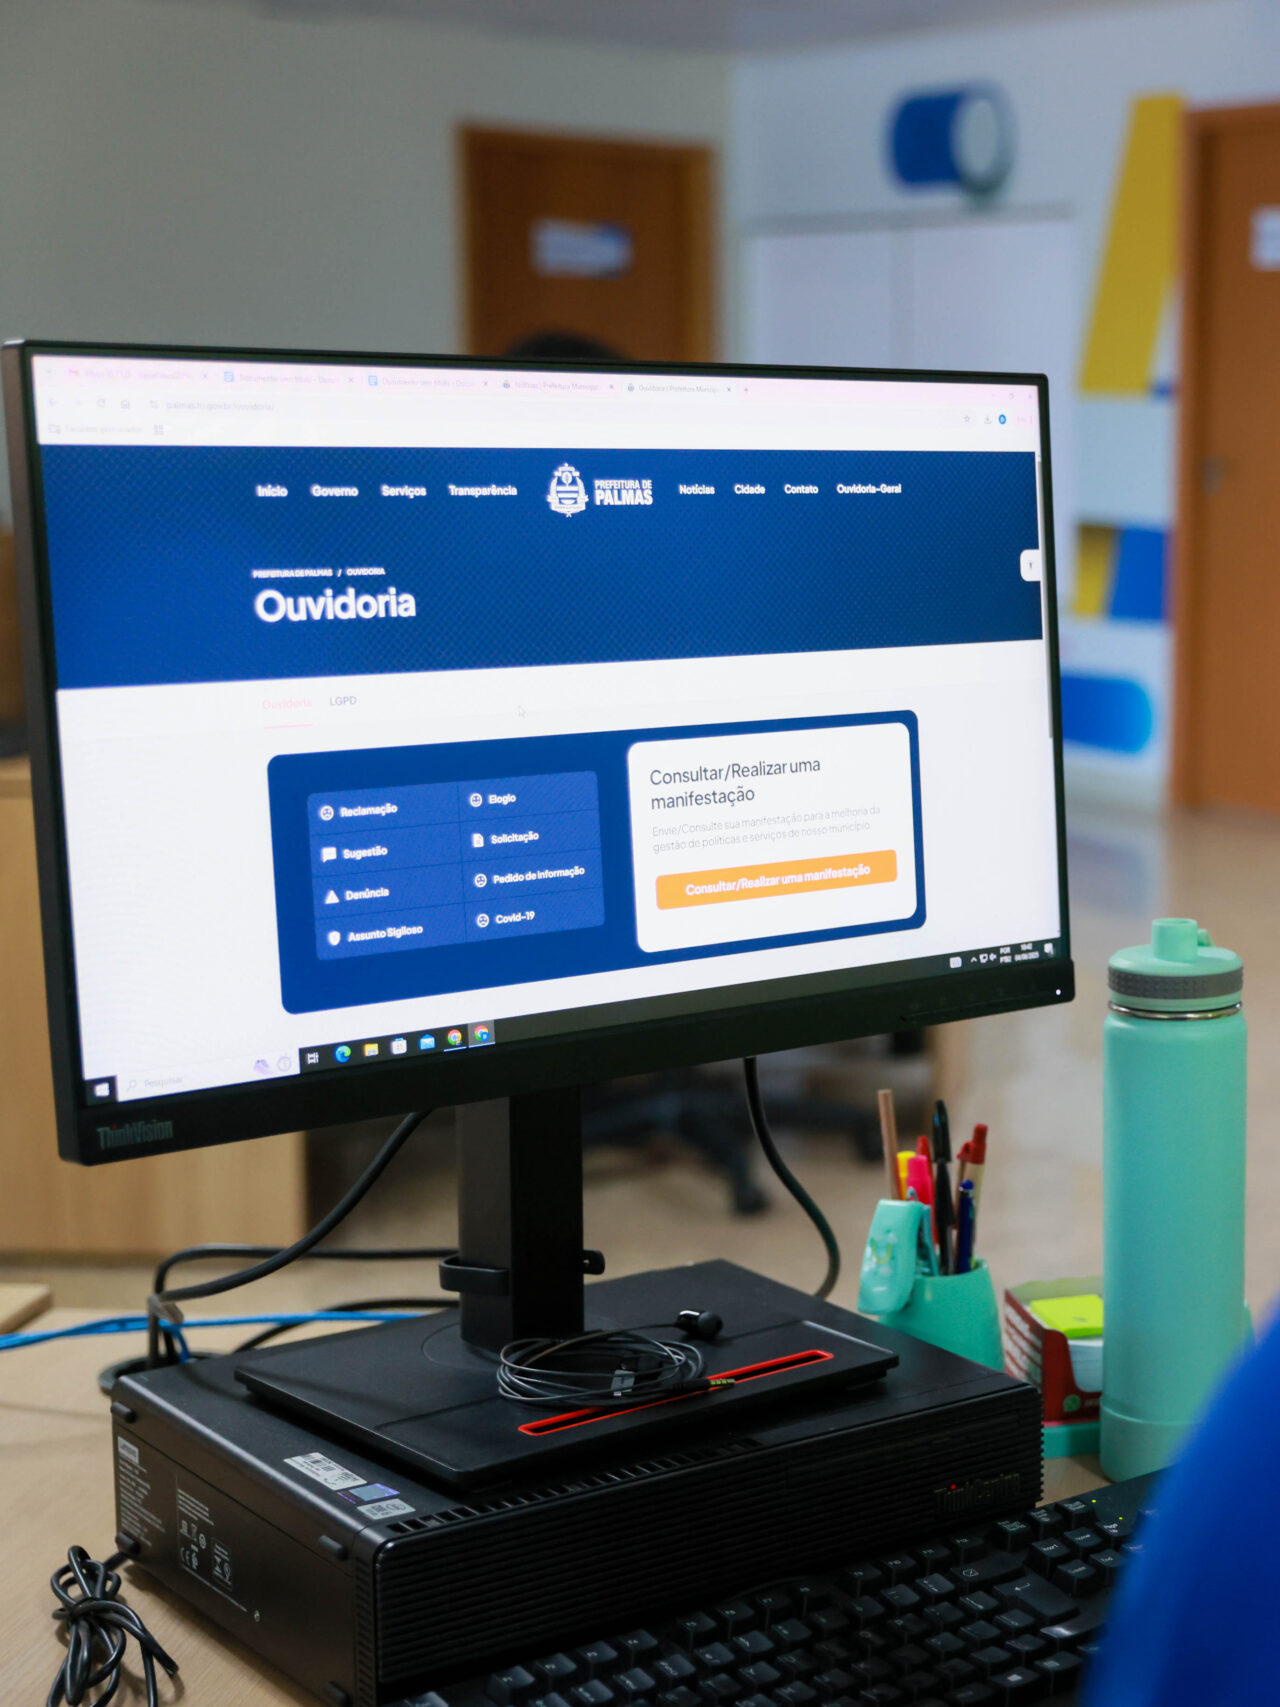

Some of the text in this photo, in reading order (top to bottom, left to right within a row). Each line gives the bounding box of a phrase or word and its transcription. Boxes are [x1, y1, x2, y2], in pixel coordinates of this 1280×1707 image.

[256, 484, 288, 497] Início
[311, 484, 359, 497] Governo
[381, 484, 427, 498] Serviços
[448, 484, 518, 498] Transparência
[595, 479, 652, 490] PREFEITURA DE
[679, 484, 715, 495] Notícias
[734, 484, 765, 495] Cidade
[784, 484, 819, 495] Contato
[836, 483, 902, 495] Ouvidoria-Geral
[594, 490, 653, 506] PALMAS
[252, 569, 295, 579] PREFEITURA
[295, 569, 305, 578] DE
[305, 569, 333, 578] PALMAS
[346, 567, 386, 577] OUVIDORIA
[255, 586, 416, 622] Ouvidoria
[329, 696, 357, 707] LGPD
[650, 760, 821, 785] Consultar/Realizar uma
[488, 794, 516, 805] Elogio
[651, 785, 755, 810] manifestação
[339, 803, 398, 818] Reclamação
[652, 820, 723, 837] Envie/Consulte
[724, 820, 741, 830] sua
[741, 813, 802, 828] manifestação
[803, 812, 824, 824] para
[831, 806, 868, 818] melhoria
[869, 806, 881, 815] da
[491, 831, 539, 845] Solicitação
[653, 836, 687, 854] gestão
[688, 837, 701, 848] de
[702, 832, 741, 848] políticas
[749, 830, 787, 843] serviços
[788, 828, 800, 839] de
[801, 827, 828, 837] nosso
[829, 820, 870, 835] município
[343, 846, 388, 860] Sugestão
[493, 872, 524, 885] Pedido
[525, 871, 537, 882] de
[685, 863, 871, 896] Consultar/Realizar uma manifestação
[345, 887, 389, 901] Denúncia
[495, 911, 535, 925] Covid-19
[348, 925, 423, 943] Assunto Sigiloso
[96, 1119, 174, 1150] ThinkVision
